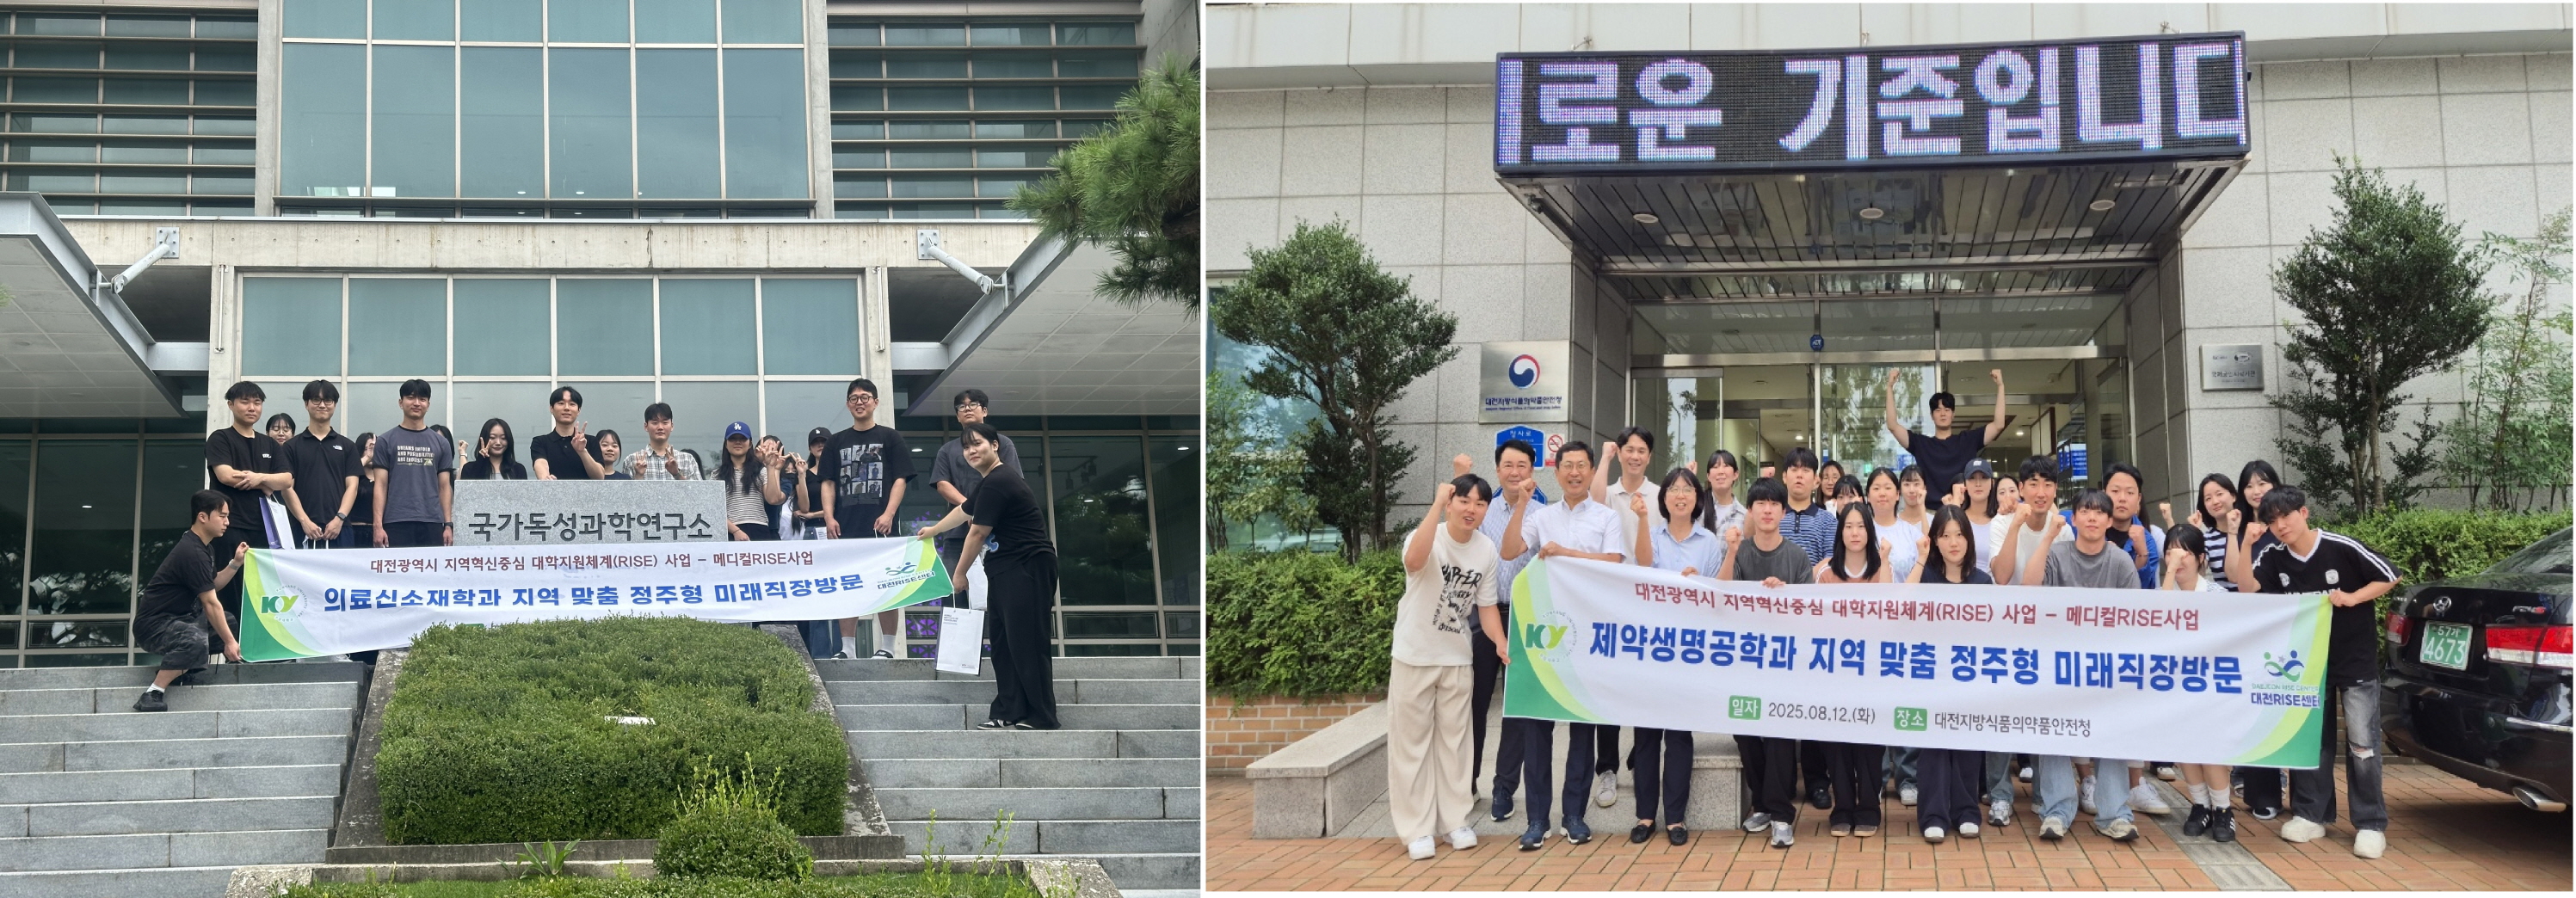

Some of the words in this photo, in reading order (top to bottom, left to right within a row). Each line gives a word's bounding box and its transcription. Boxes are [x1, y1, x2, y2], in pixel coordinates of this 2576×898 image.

[1499, 57, 1722, 165] 로운
[1485, 397, 1562, 406] 대전지방식품의약품안전청
[469, 513, 713, 542] 국가독성과학연구소
[370, 557, 438, 574] 대전광역시
[444, 556, 525, 572] 지역혁신중심
[532, 554, 658, 570] 대학지원체계(RISE)
[664, 553, 691, 568] 사업
[713, 551, 813, 567] 메디컬RISE사업
[324, 587, 502, 612] 의료신소재학과
[513, 588, 560, 607] 지역
[571, 587, 619, 606] 맞춤
[630, 585, 703, 605] 정주형
[714, 573, 864, 603] 미래직장방문
[877, 571, 935, 589] 대전RISE센터
[1635, 582, 1716, 608] 대전광역시
[1723, 594, 1824, 616] 지역혁신중심
[1832, 599, 1994, 623] 대학지원체계(RISE)
[2002, 604, 2037, 624] 사업
[2066, 606, 2199, 631] 메디컬RISE사업
[1589, 621, 1797, 671] 제약생명공학과
[1809, 637, 1866, 676] 지역
[1880, 641, 1937, 680] 맞춤
[1950, 645, 2039, 686] 정주형
[2054, 650, 2243, 694] 미래직장방문
[2423, 637, 2466, 664] 4673
[2250, 692, 2320, 707] 대전RISE센터
[1732, 698, 1759, 717] 일자
[1768, 702, 1876, 725] 2025.08.12.(화)
[1896, 710, 1925, 729] 장소
[1934, 711, 2092, 738] 대전지방식품의약품안전청
